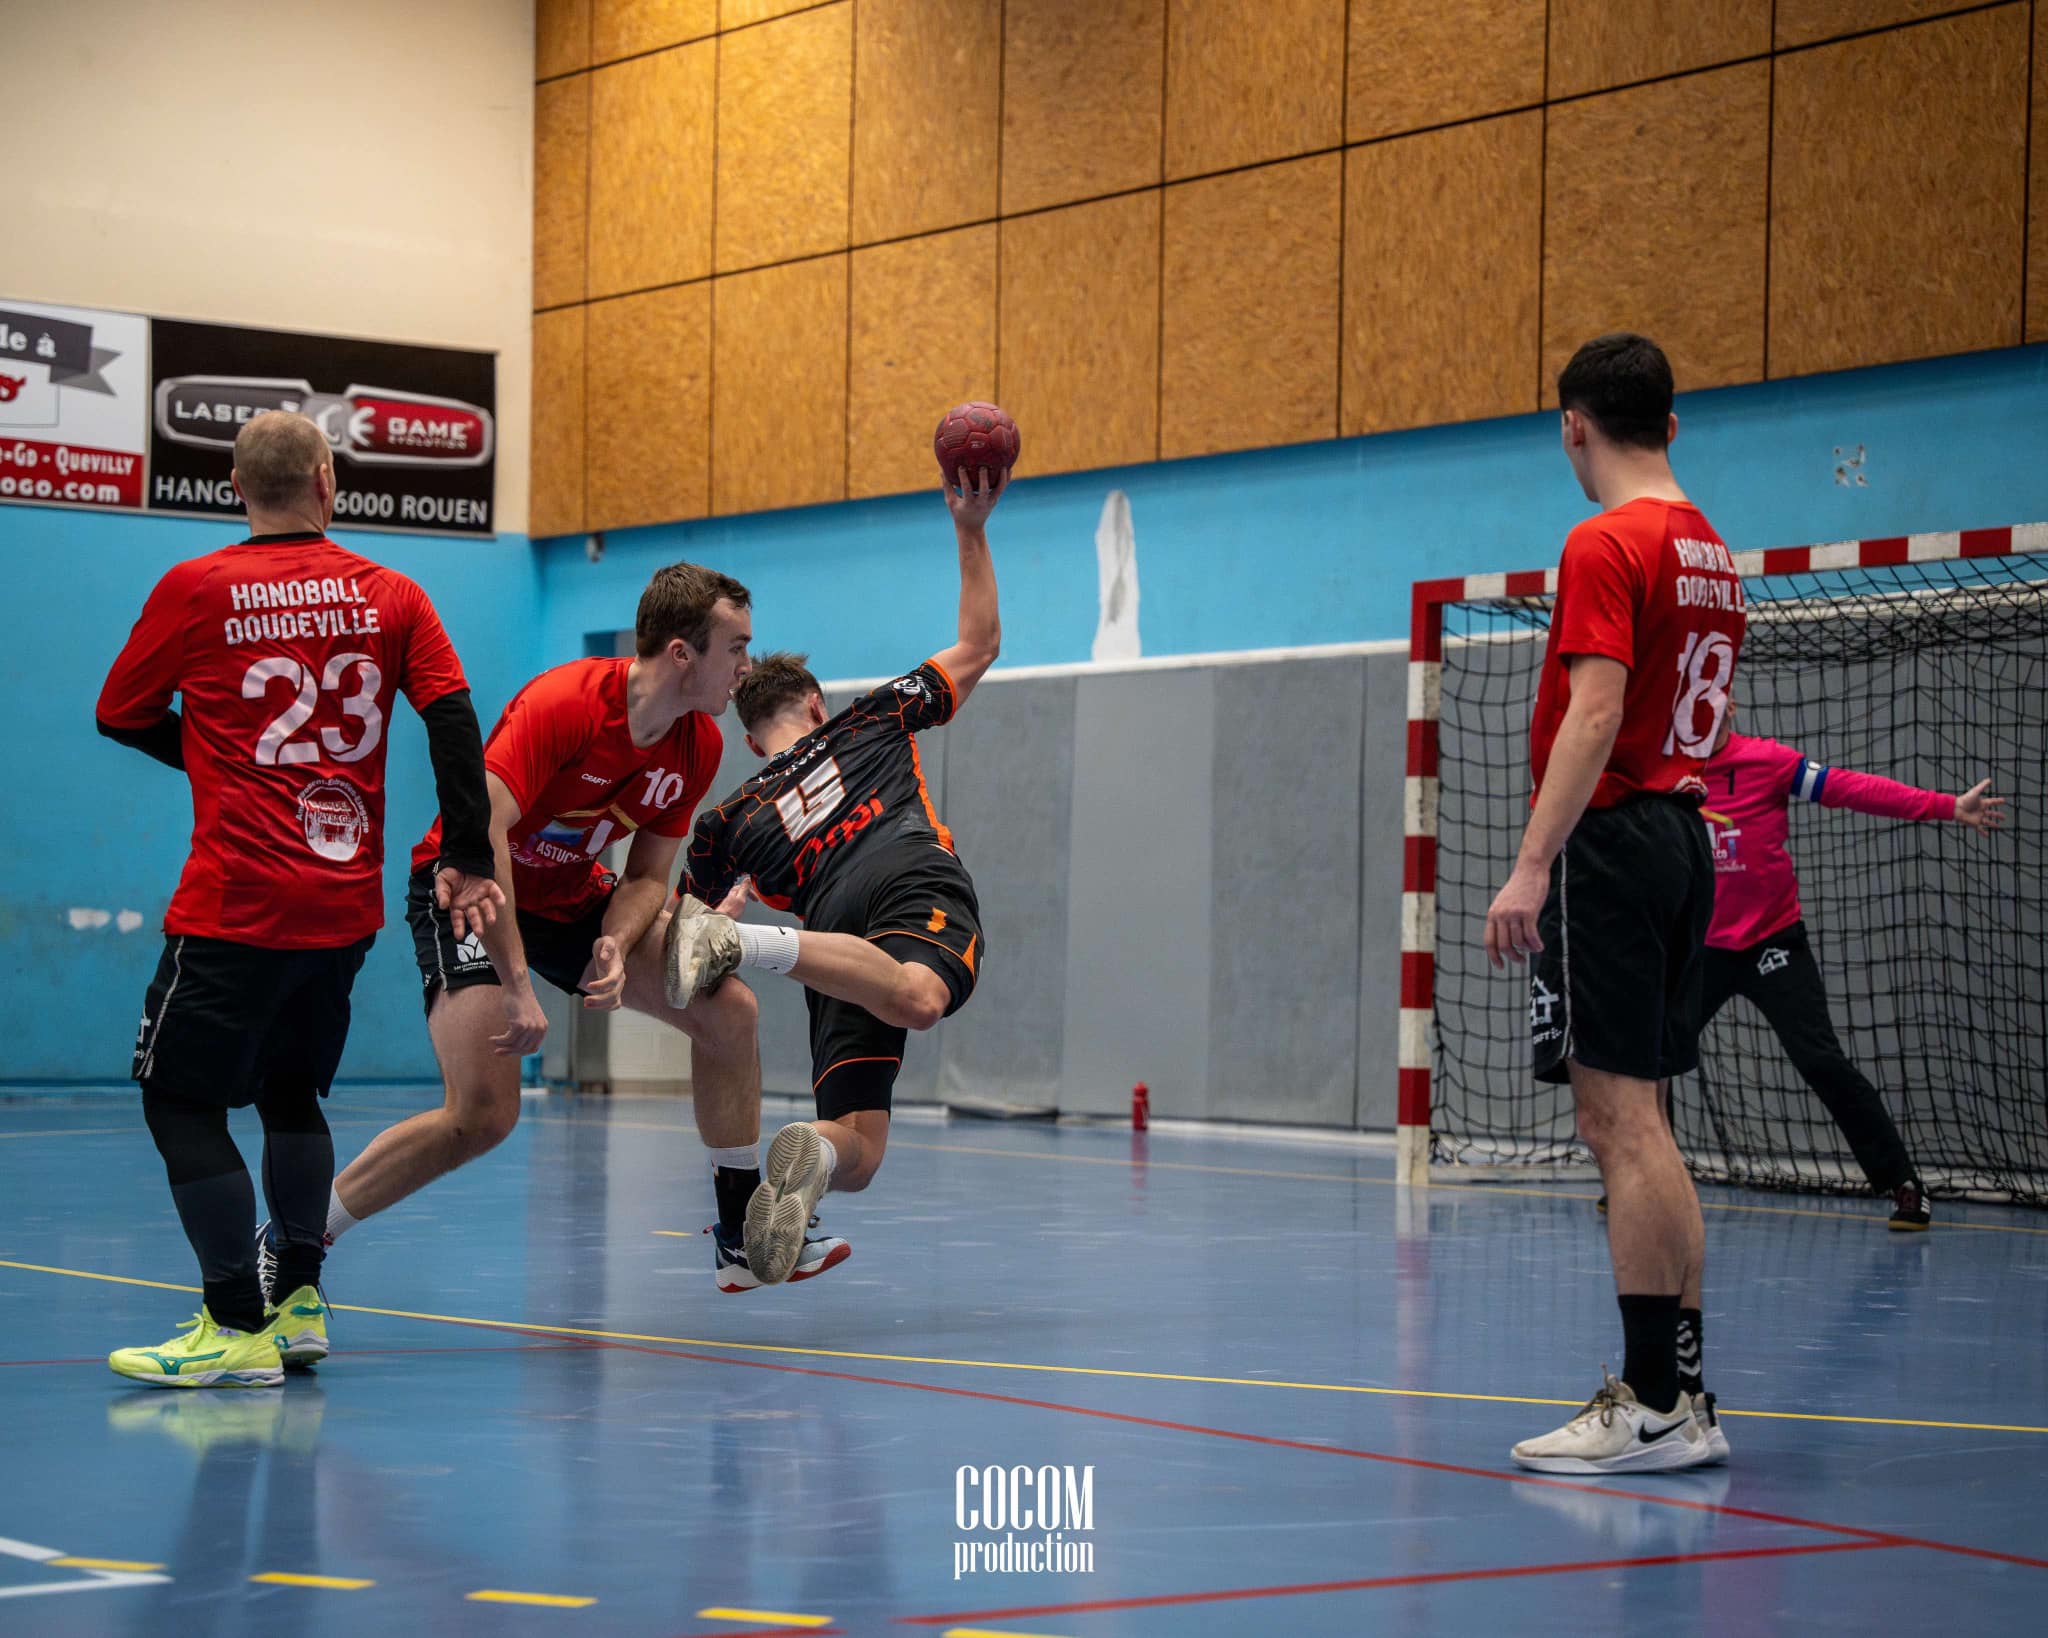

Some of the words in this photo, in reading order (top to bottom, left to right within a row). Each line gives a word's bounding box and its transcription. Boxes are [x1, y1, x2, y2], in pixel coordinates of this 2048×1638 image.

[388, 416, 467, 441] GAME
[155, 475, 244, 506] HANG
[401, 494, 488, 524] ROUEN
[230, 577, 367, 611] HANDBALL
[224, 608, 381, 646] DOUDEVILLE
[241, 652, 383, 766] 23
[1661, 631, 1734, 759] 18
[639, 767, 685, 810] 10
[1723, 768, 1736, 796] 1
